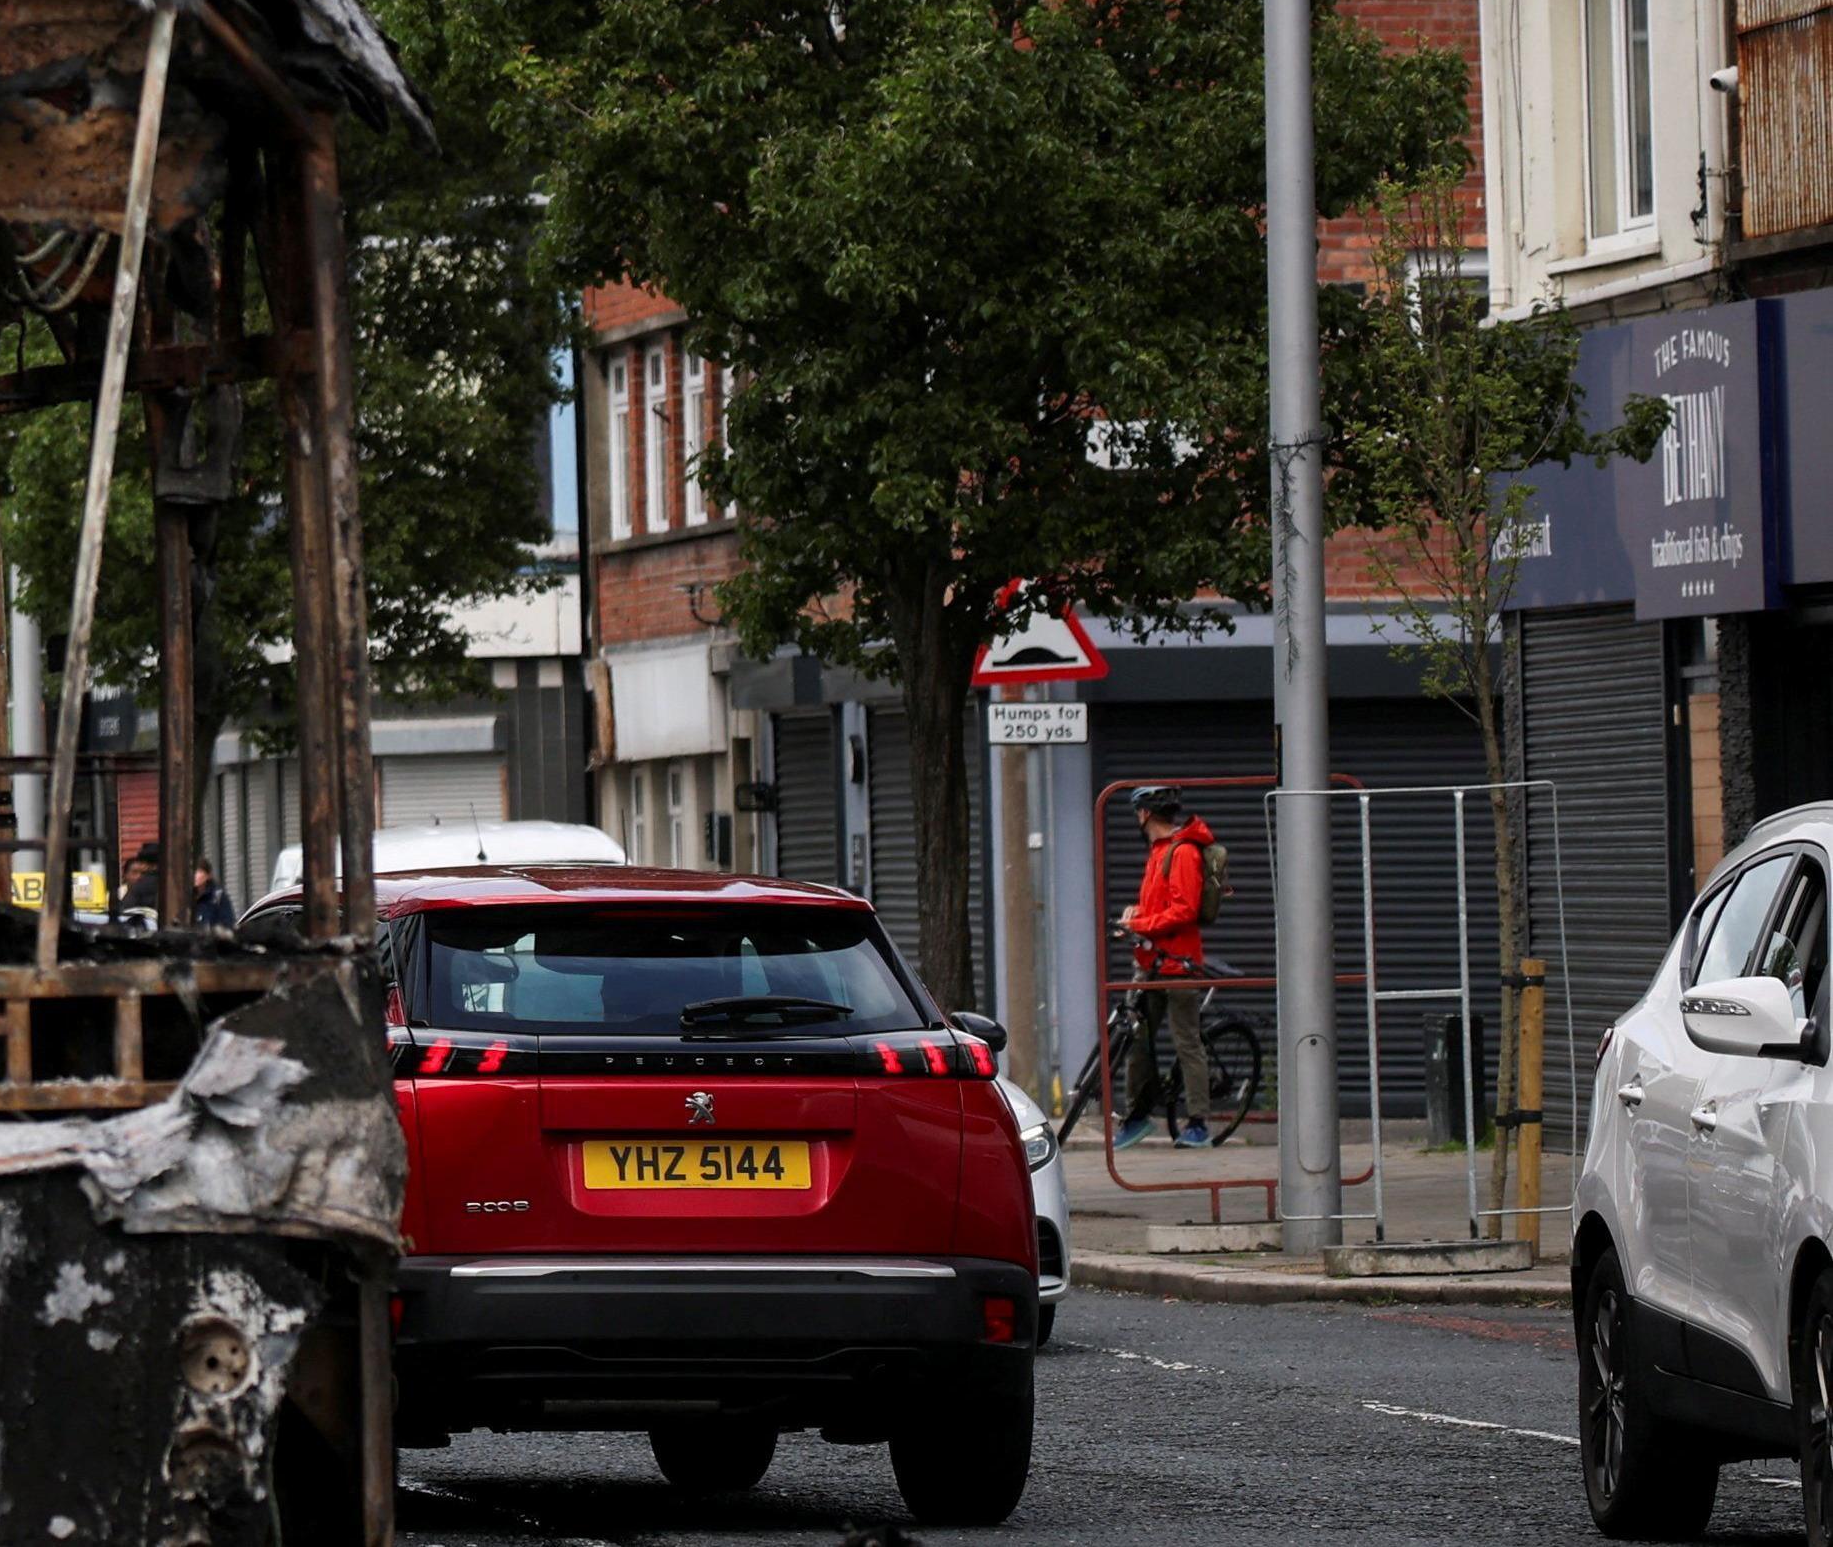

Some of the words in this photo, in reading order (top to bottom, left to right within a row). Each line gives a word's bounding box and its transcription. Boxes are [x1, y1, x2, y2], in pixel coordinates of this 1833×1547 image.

[1654, 335, 1679, 378] THE
[1681, 329, 1730, 370] FAMOUS
[1662, 385, 1725, 506] BETHANY
[1651, 527, 1693, 567] traditional
[1694, 525, 1710, 563] fish
[1711, 526, 1719, 563] &
[1720, 522, 1743, 569] chips
[994, 707, 1051, 721] Humps
[1058, 707, 1081, 720] for
[1004, 724, 1038, 739] 250
[1045, 724, 1073, 741] yds
[605, 1056, 793, 1066] PEUGEOT
[609, 1146, 686, 1181] YHZ
[699, 1146, 785, 1181] 5144
[465, 1199, 531, 1213] 2008
